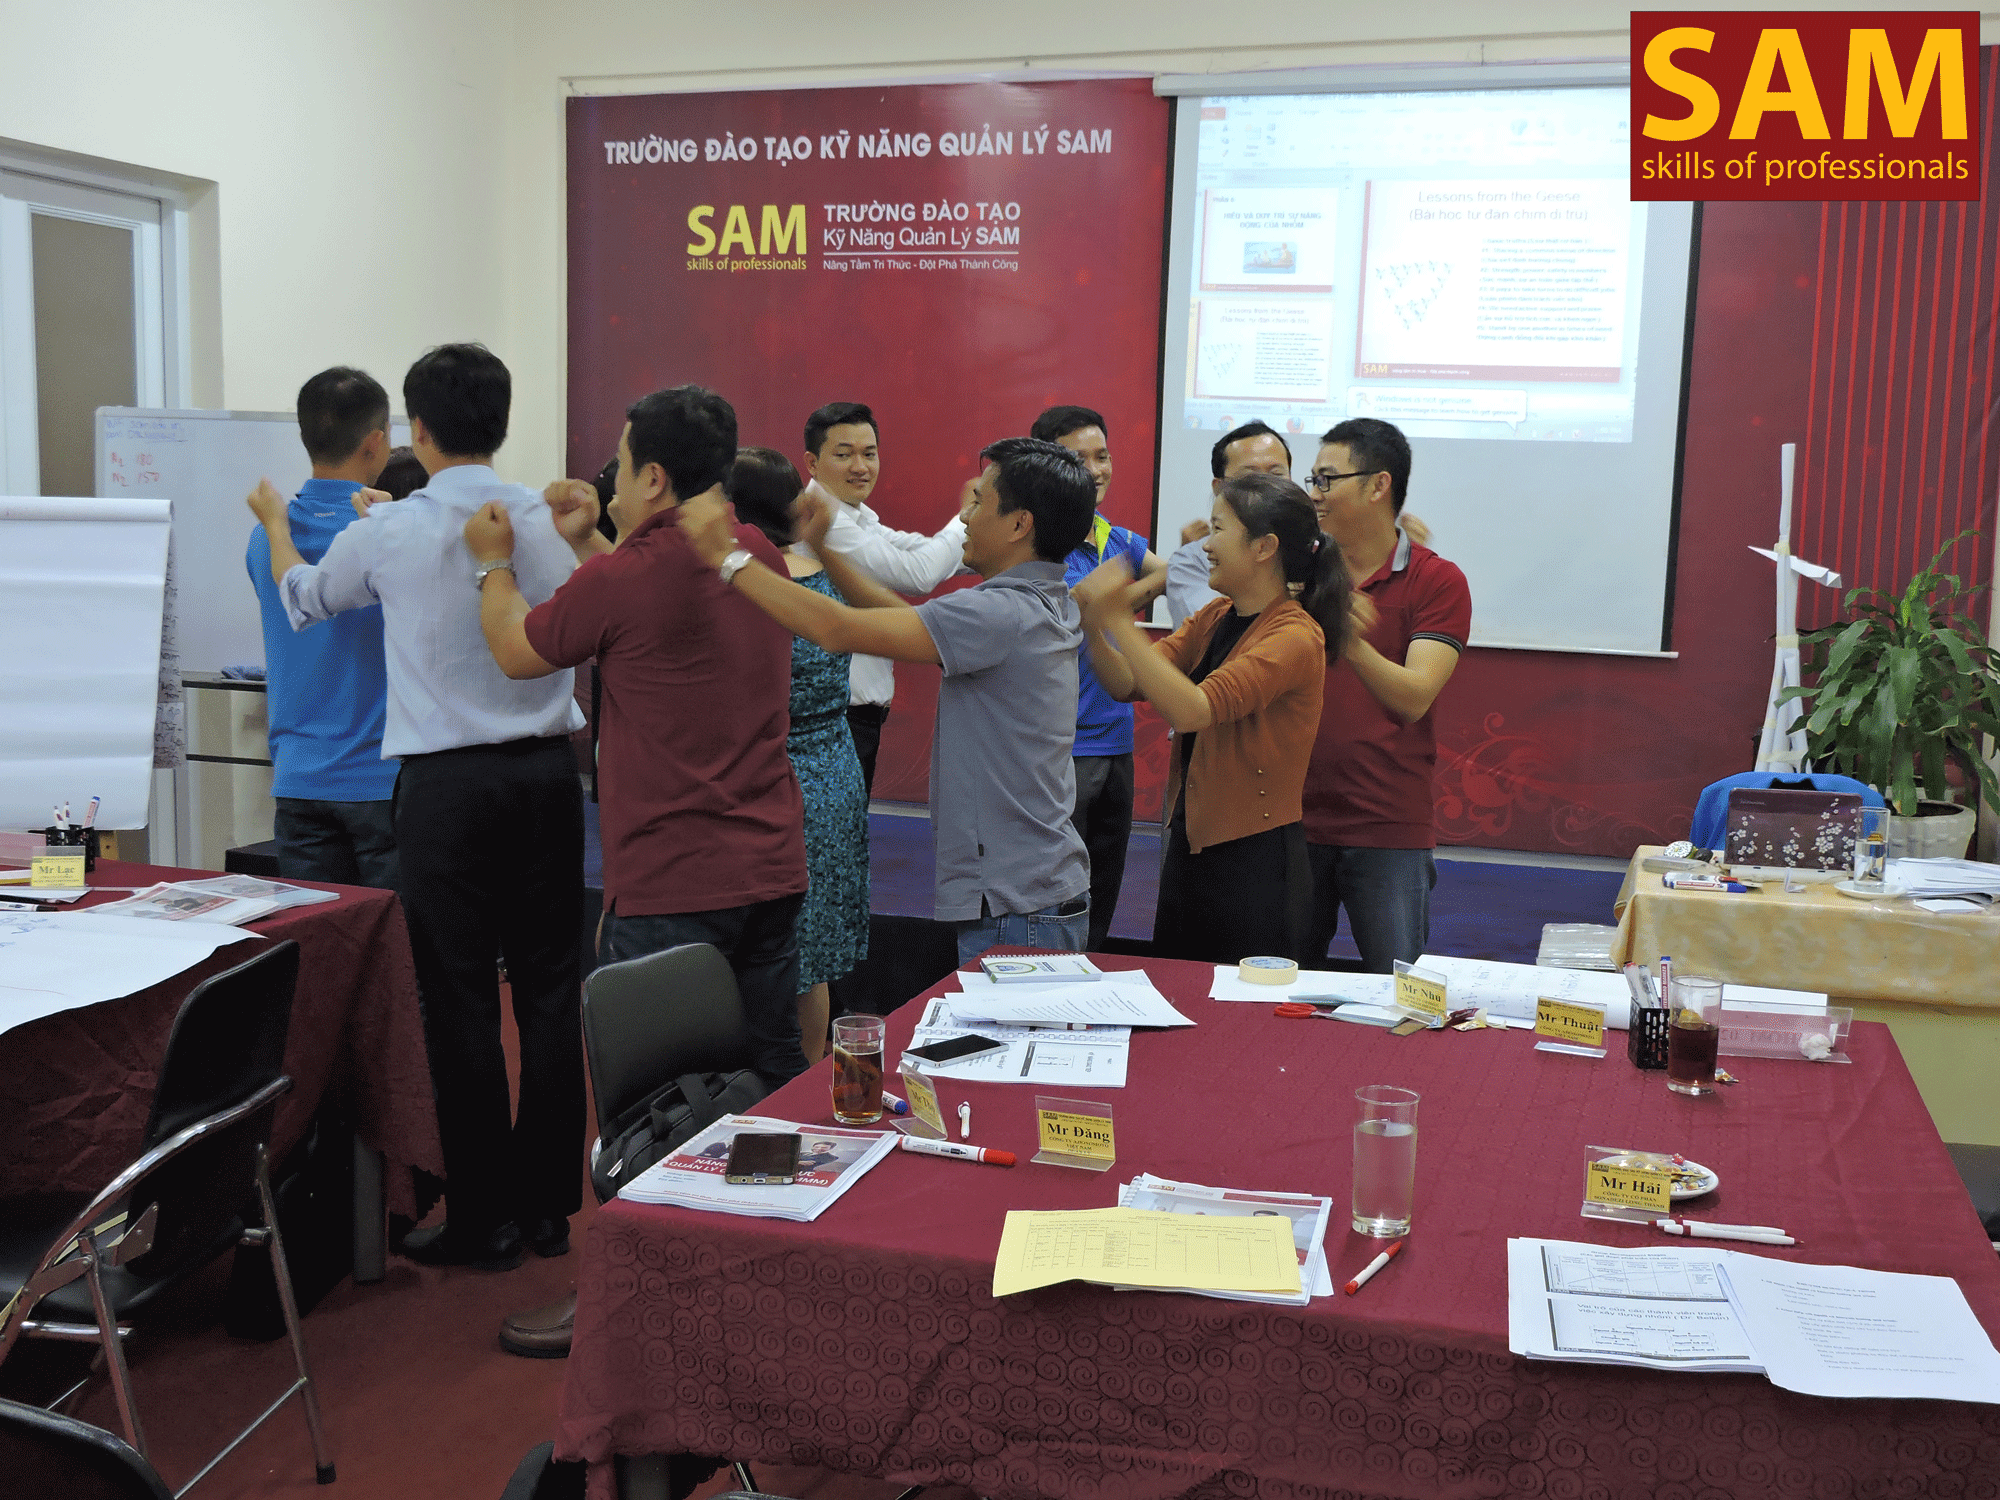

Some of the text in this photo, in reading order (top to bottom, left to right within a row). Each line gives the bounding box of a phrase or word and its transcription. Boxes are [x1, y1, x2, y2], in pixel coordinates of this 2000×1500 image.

[604, 123, 1112, 167] TRƯỜNG ĐÀO TẠO KỸ NĂNG QUẢN LÝ SAM
[1418, 189, 1581, 202] Lessons from the Geese
[823, 199, 1021, 225] TRƯỜNG ĐÀO TẠO
[687, 204, 807, 256] SAM
[823, 226, 1020, 250] Kỹ Năng Quản Lý SAM
[687, 257, 807, 273] skills of professionals
[823, 260, 848, 272] Nâng
[887, 259, 911, 270] Thức
[919, 259, 936, 271] Đột
[992, 259, 1019, 272] Công
[1363, 364, 1388, 374] SAM
[1375, 395, 1412, 403] Windows
[39, 865, 54, 874] Mr
[1403, 982, 1418, 995] Mr
[1538, 1011, 1598, 1033] Mr Thuật
[1047, 1122, 1111, 1143] Mr Đăng
[1600, 1176, 1661, 1195] Mr Hải
